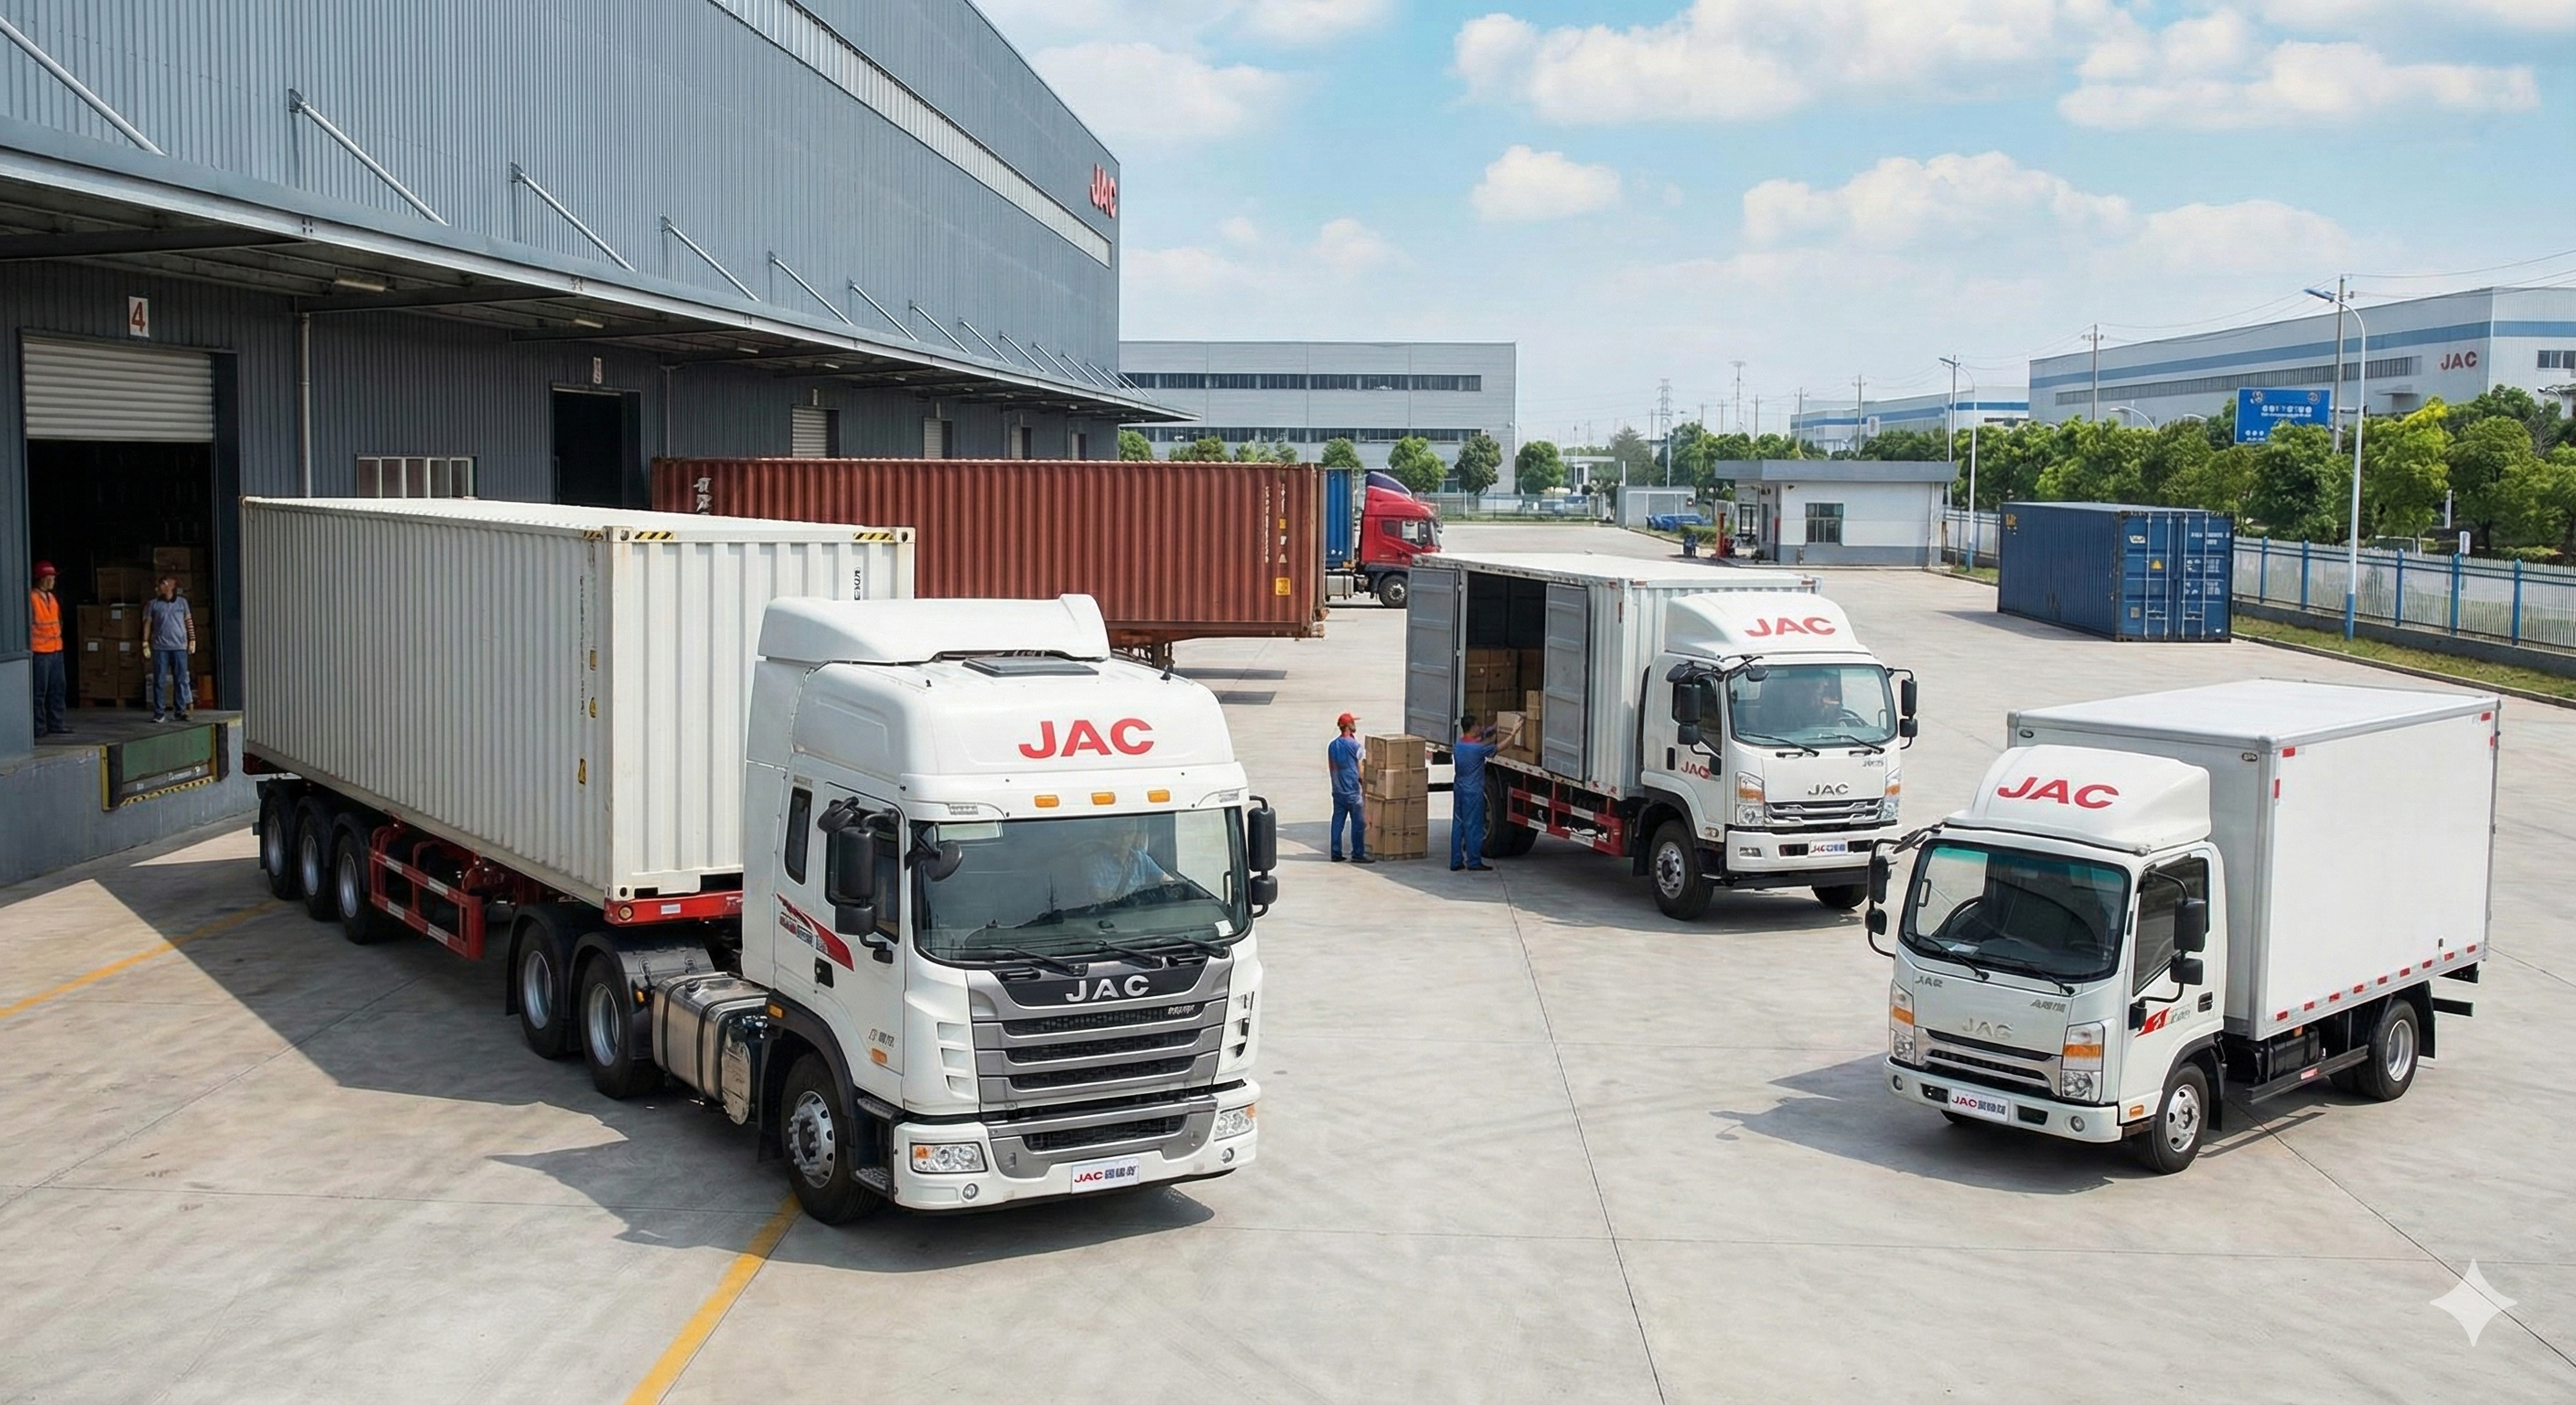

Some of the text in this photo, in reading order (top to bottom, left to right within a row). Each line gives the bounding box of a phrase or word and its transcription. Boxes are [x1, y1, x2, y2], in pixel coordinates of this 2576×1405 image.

[1089, 163, 1117, 219] JAC
[131, 301, 146, 333] 4
[2441, 351, 2477, 370] JAC
[1744, 617, 1836, 638] JAC
[1018, 717, 1154, 759] JAC
[1808, 783, 1849, 797] JAC
[1997, 777, 2120, 810] JAC
[1065, 974, 1150, 1003] JAC
[1962, 1018, 2013, 1039] JAC
[1074, 1172, 1103, 1183] JAC
